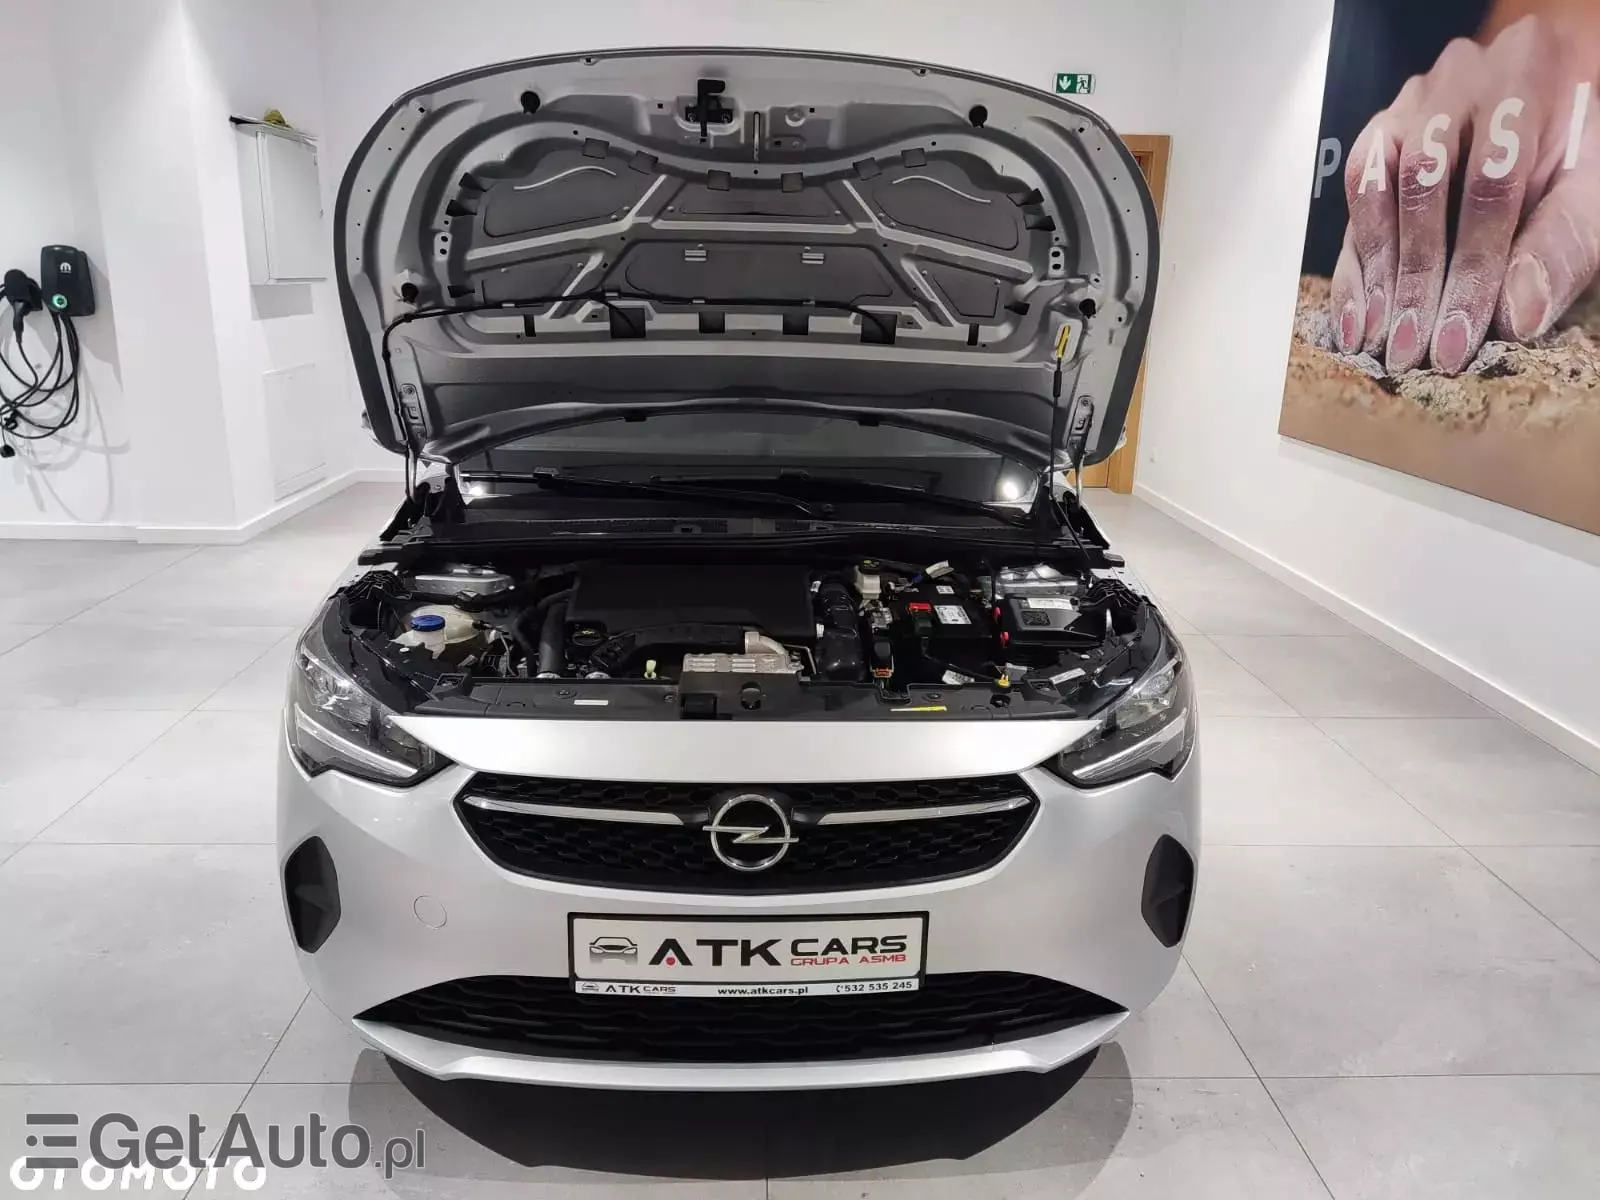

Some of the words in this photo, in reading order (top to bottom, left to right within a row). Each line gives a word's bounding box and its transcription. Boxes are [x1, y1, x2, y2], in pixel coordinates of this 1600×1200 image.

[1313, 81, 1592, 200] PASSI
[647, 937, 783, 967] ATK
[789, 934, 908, 957] CARS
[790, 956, 850, 967] GRUPA
[858, 954, 907, 965] ASMB
[604, 984, 641, 994] ATK
[643, 985, 677, 994] CARS
[716, 986, 809, 996] www.atkcars.pl
[844, 983, 865, 993] 532
[868, 982, 889, 992] 535
[892, 981, 913, 990] 245
